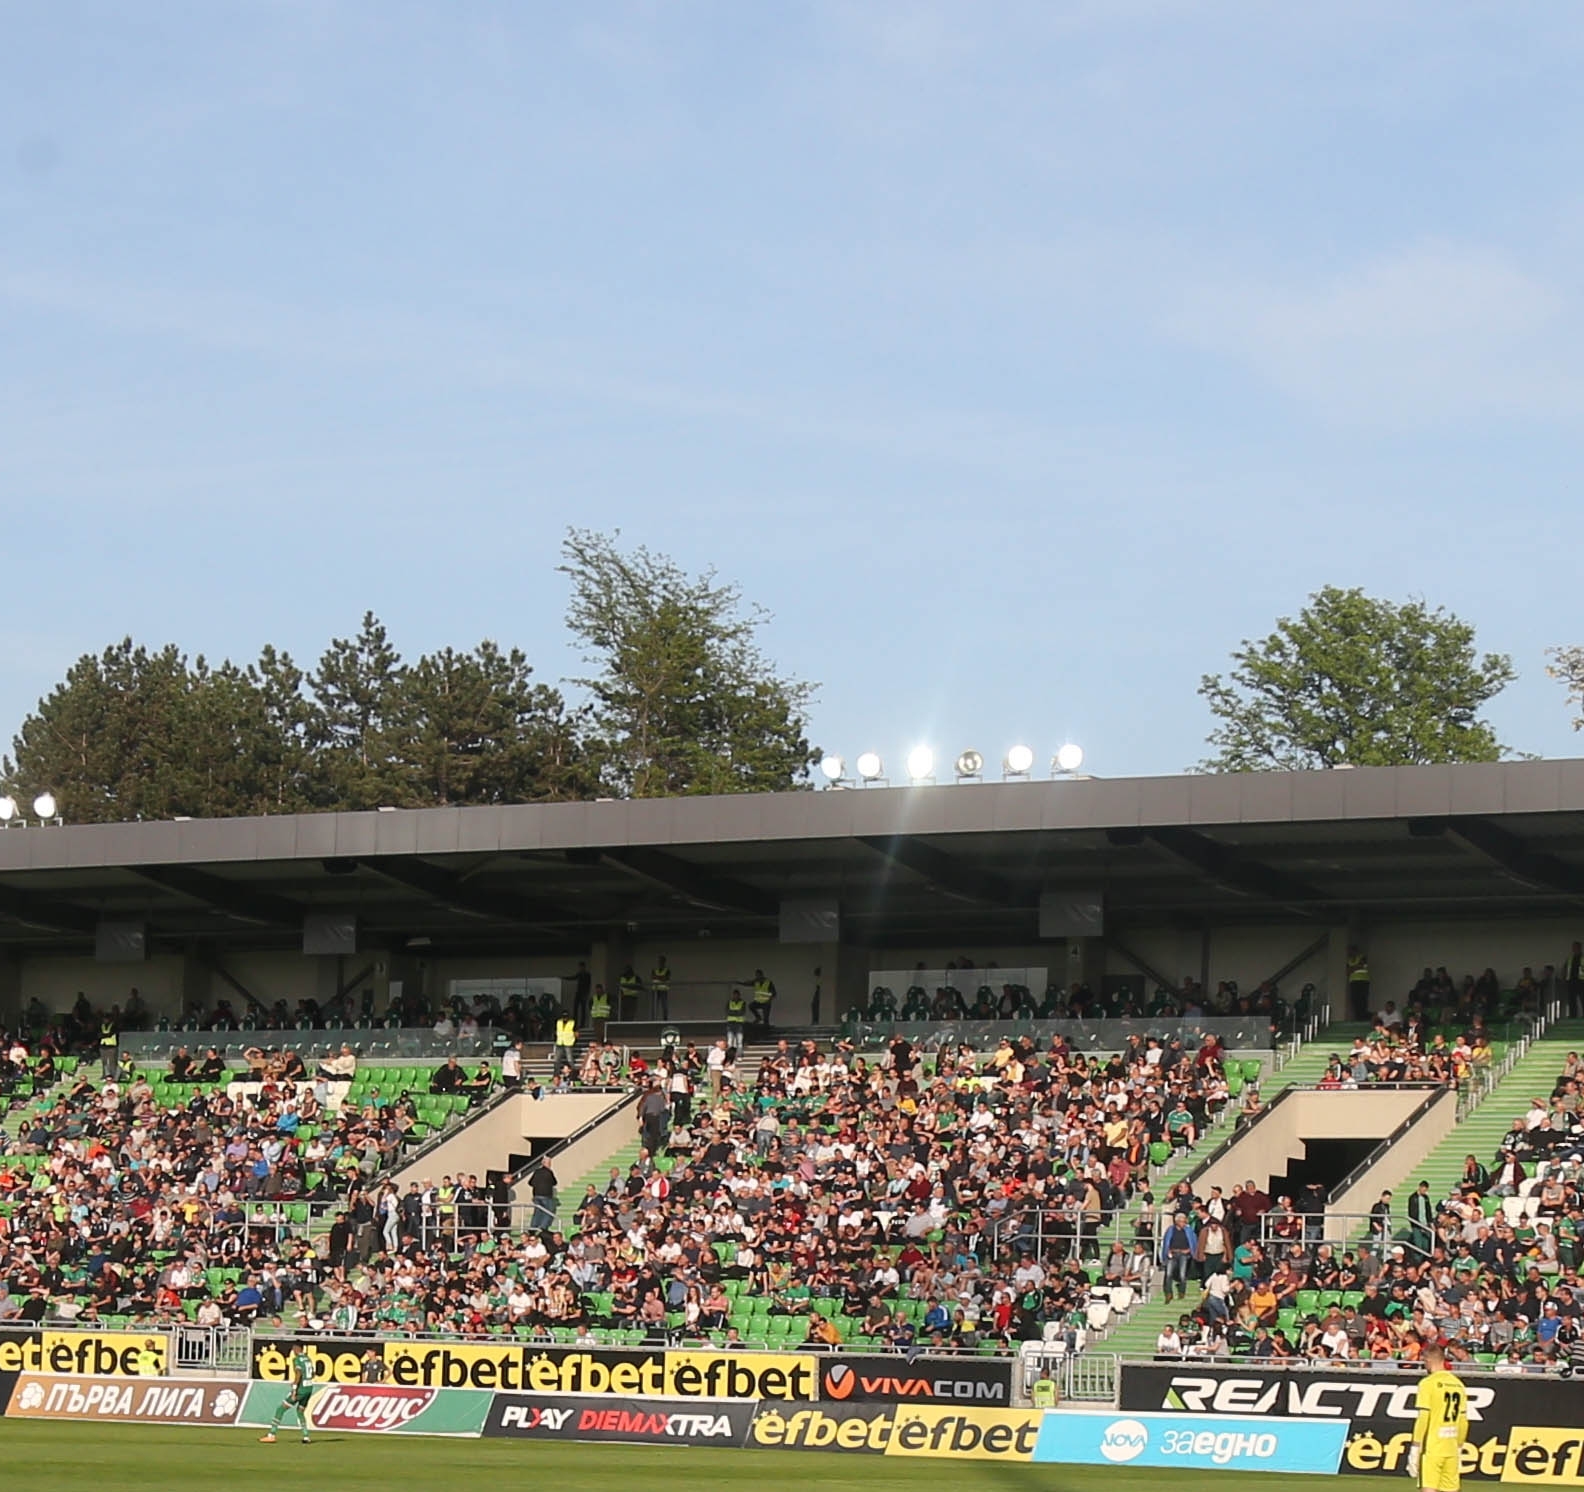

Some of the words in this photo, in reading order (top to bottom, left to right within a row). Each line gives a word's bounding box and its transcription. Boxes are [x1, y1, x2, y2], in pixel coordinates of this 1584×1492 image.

[392, 1349, 519, 1389] efbet
[528, 1353, 663, 1395] efbet
[673, 1359, 811, 1400] efbet
[860, 1376, 1004, 1400] VIVACOM
[44, 1383, 131, 1415] ПЪРВА
[136, 1387, 205, 1418] ЛИГА
[1162, 1376, 1496, 1422] REACTOR
[1443, 1391, 1461, 1423] 23
[753, 1410, 894, 1450] efbet
[899, 1416, 1040, 1454] efbet
[1346, 1433, 1509, 1476] efet
